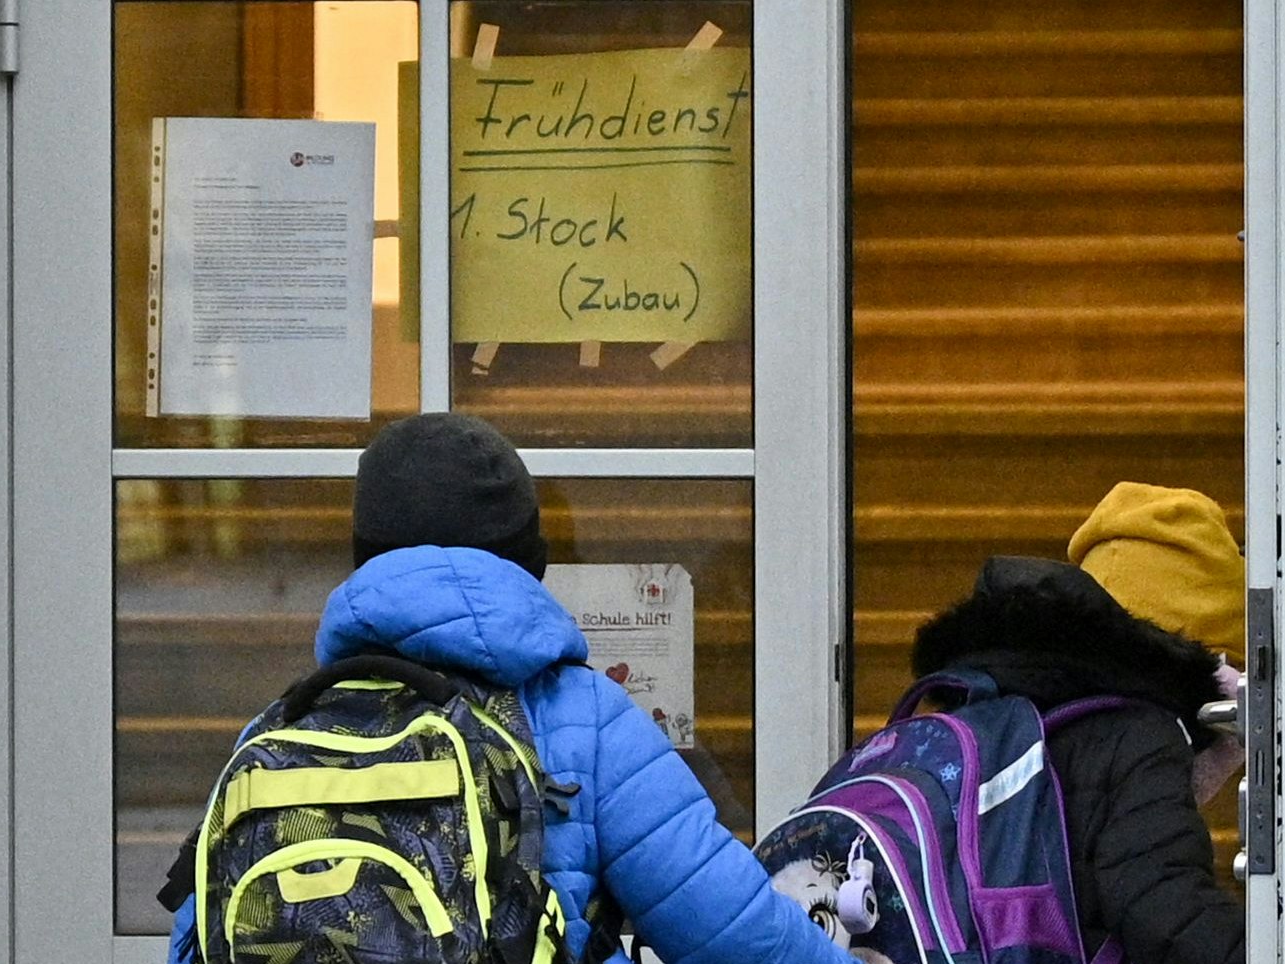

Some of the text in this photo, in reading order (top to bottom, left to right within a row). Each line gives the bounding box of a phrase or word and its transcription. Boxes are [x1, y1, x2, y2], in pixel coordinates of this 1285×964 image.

[476, 71, 749, 139] Frühdienst
[451, 192, 628, 248] 1. Stock
[558, 262, 700, 323] (Zubau)
[582, 611, 631, 626] Schule
[635, 611, 672, 626] hilft!
